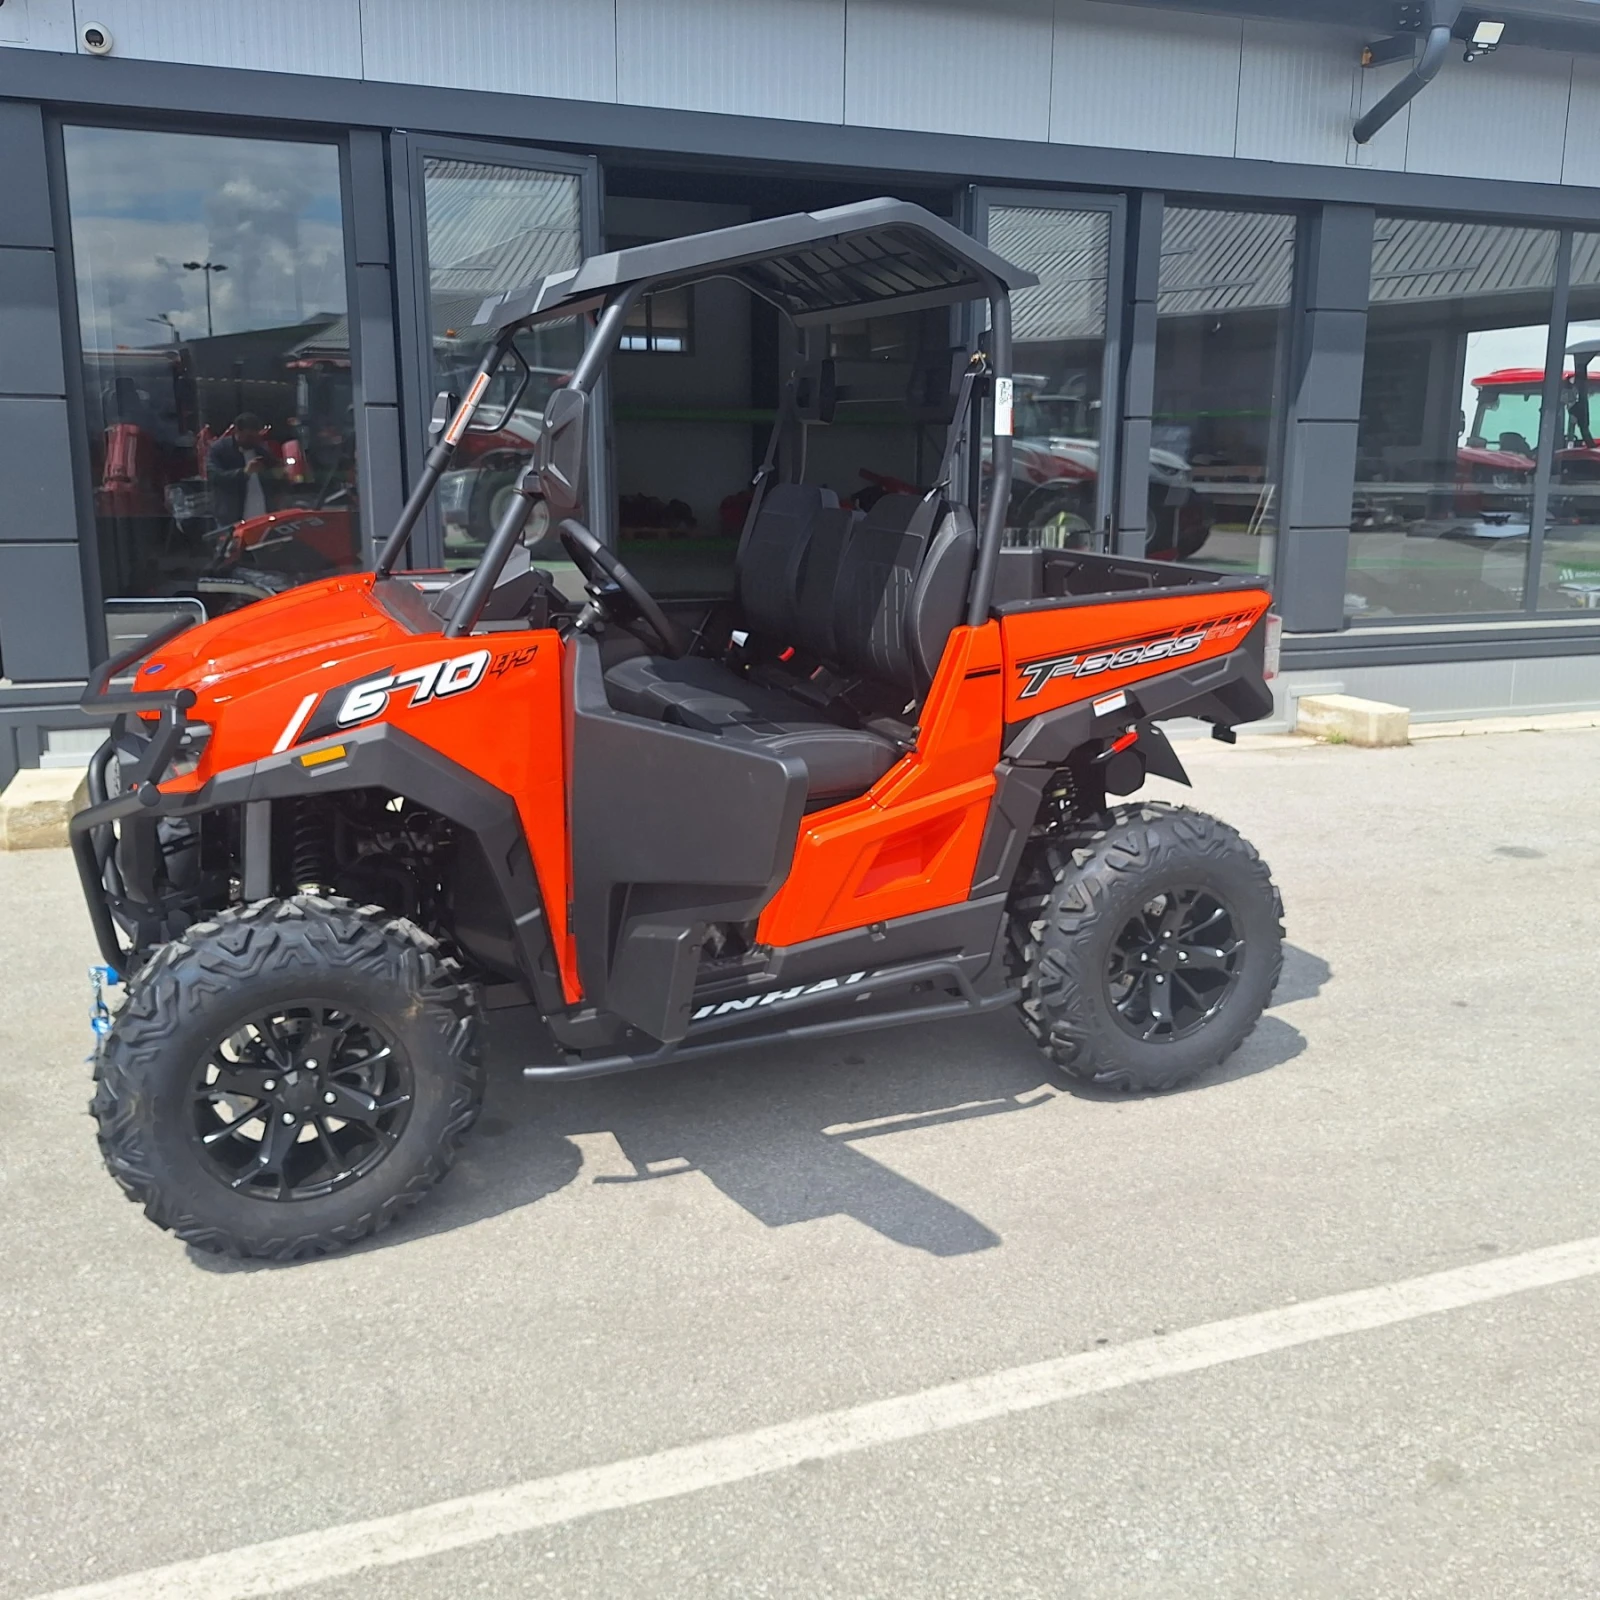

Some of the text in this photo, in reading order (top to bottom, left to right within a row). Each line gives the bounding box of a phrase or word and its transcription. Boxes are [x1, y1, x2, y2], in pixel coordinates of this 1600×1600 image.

[336, 645, 538, 729] 670 EPS
[1018, 631, 1207, 699] T-BOSS
